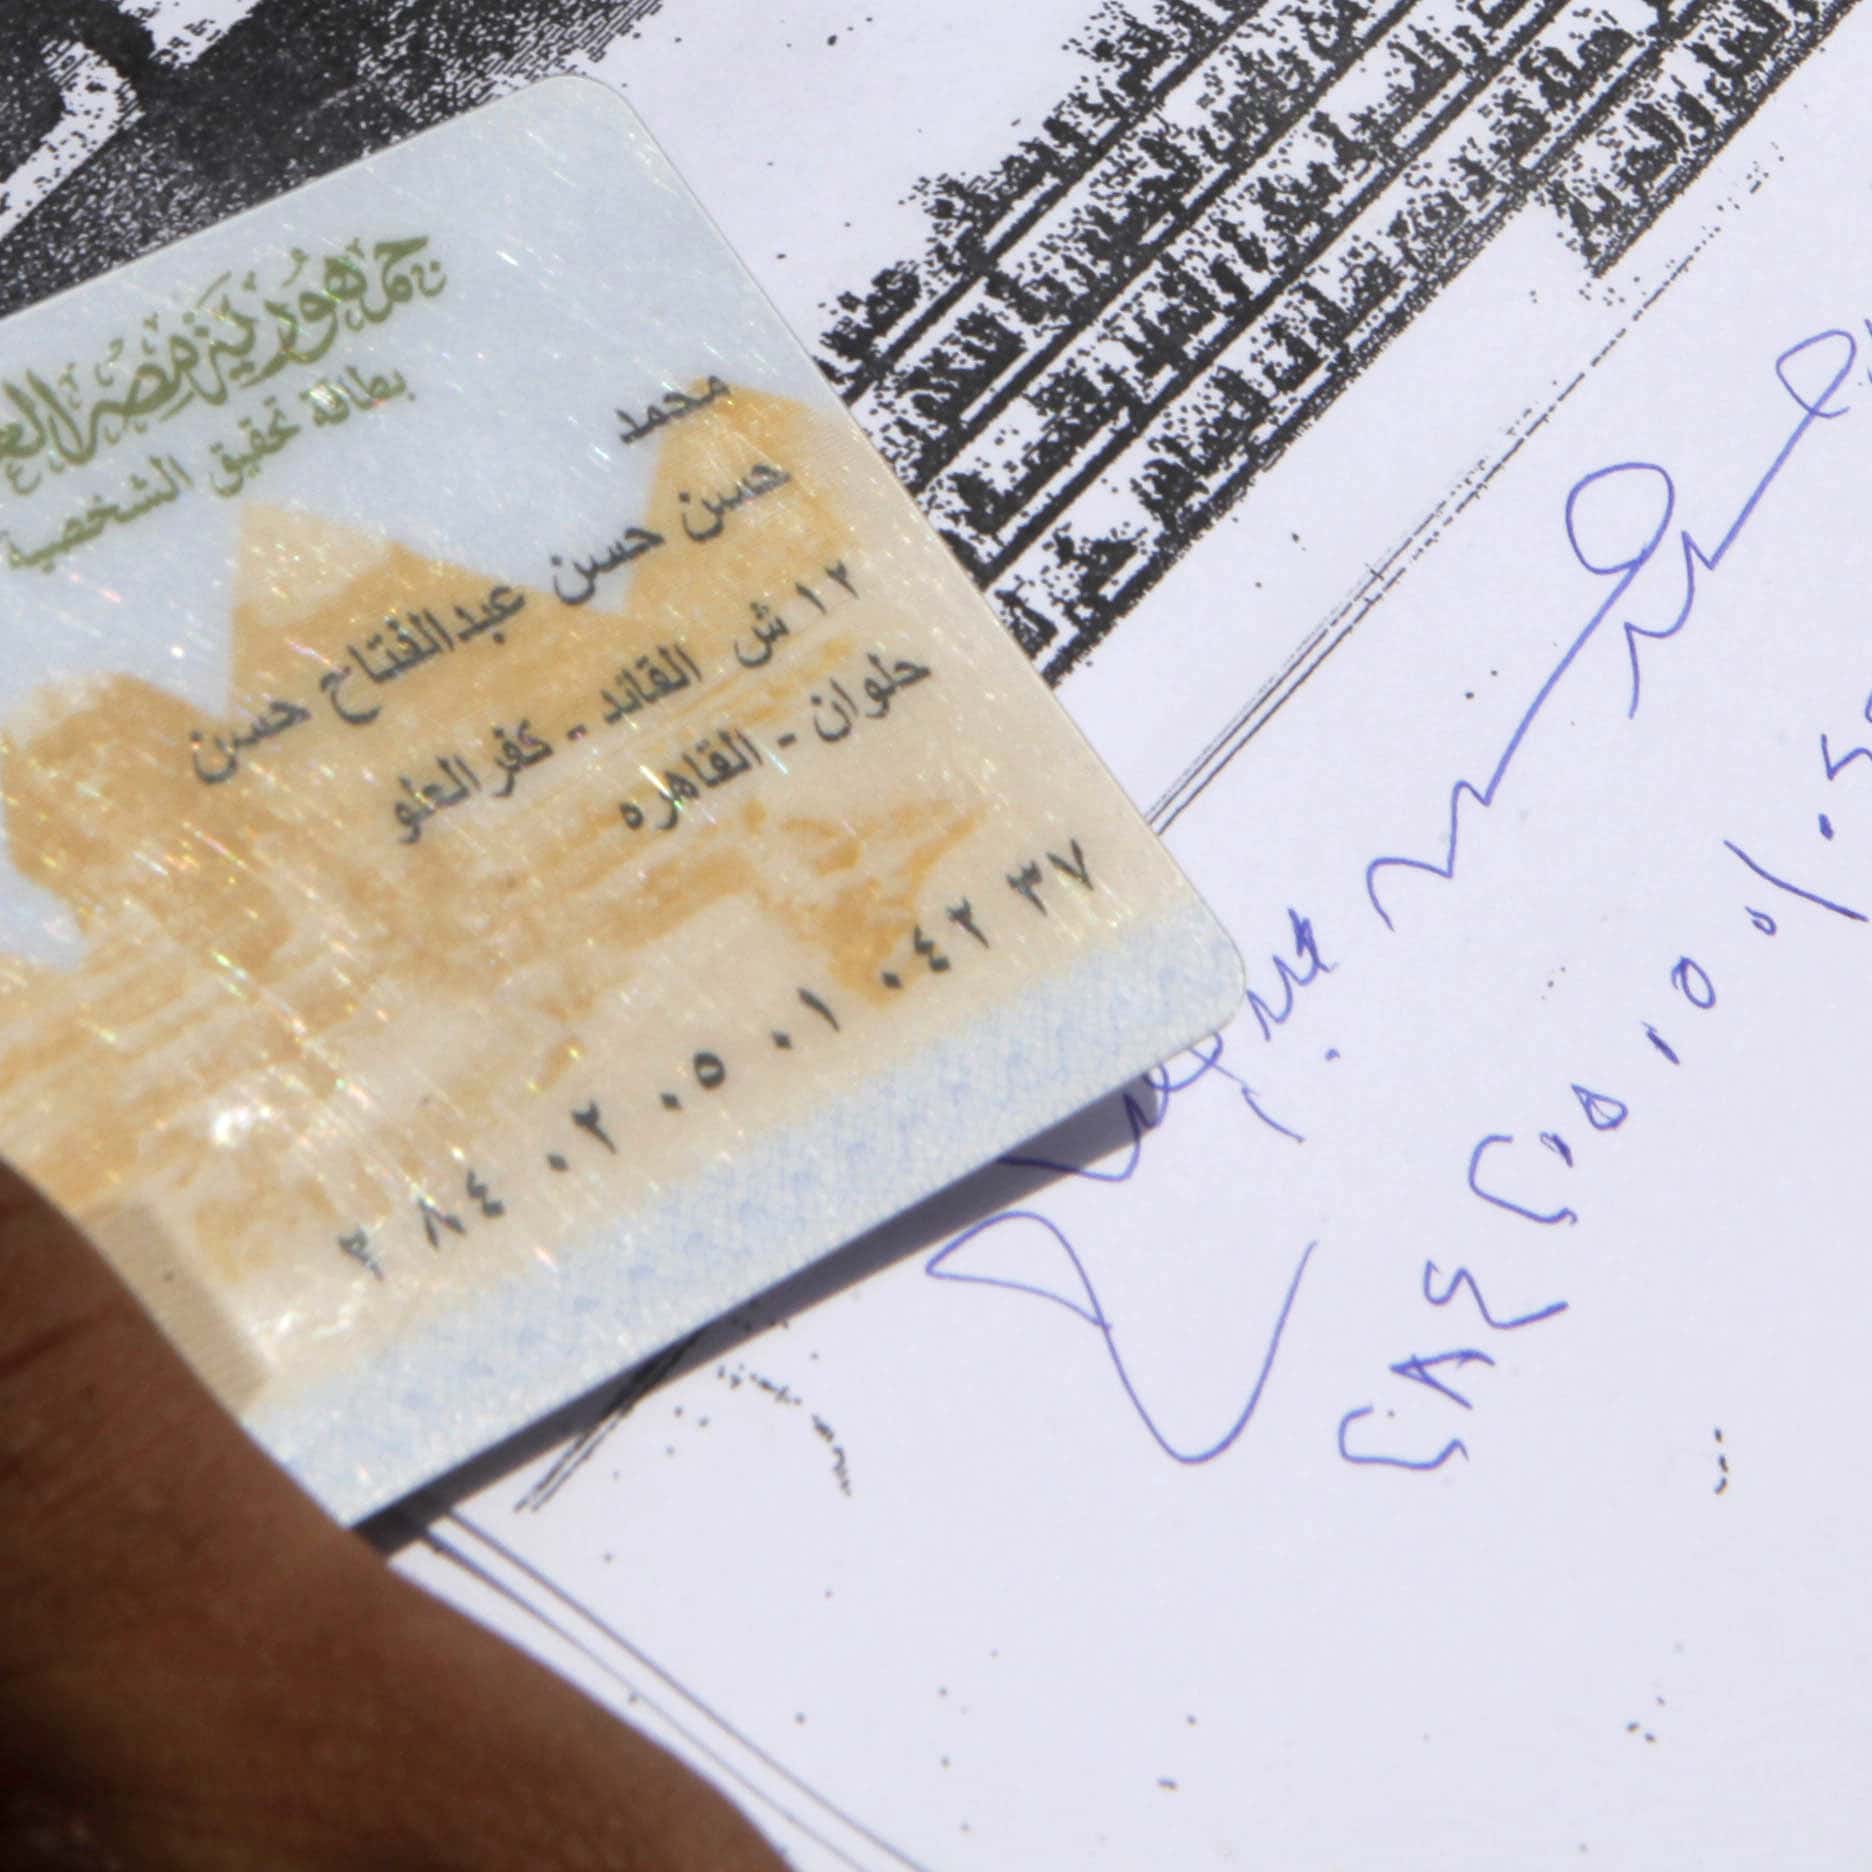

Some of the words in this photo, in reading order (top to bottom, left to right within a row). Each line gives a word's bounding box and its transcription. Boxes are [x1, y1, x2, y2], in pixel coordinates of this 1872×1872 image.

[188, 235, 448, 403] جمهورية
[311, 362, 417, 428] بطاقة
[617, 373, 733, 446] محمد
[208, 394, 300, 499] تحقيق
[677, 459, 794, 543] حسن
[548, 521, 666, 605] حسن
[733, 594, 792, 667] ش
[812, 644, 932, 746] حلوان
[188, 696, 311, 785] حسن
